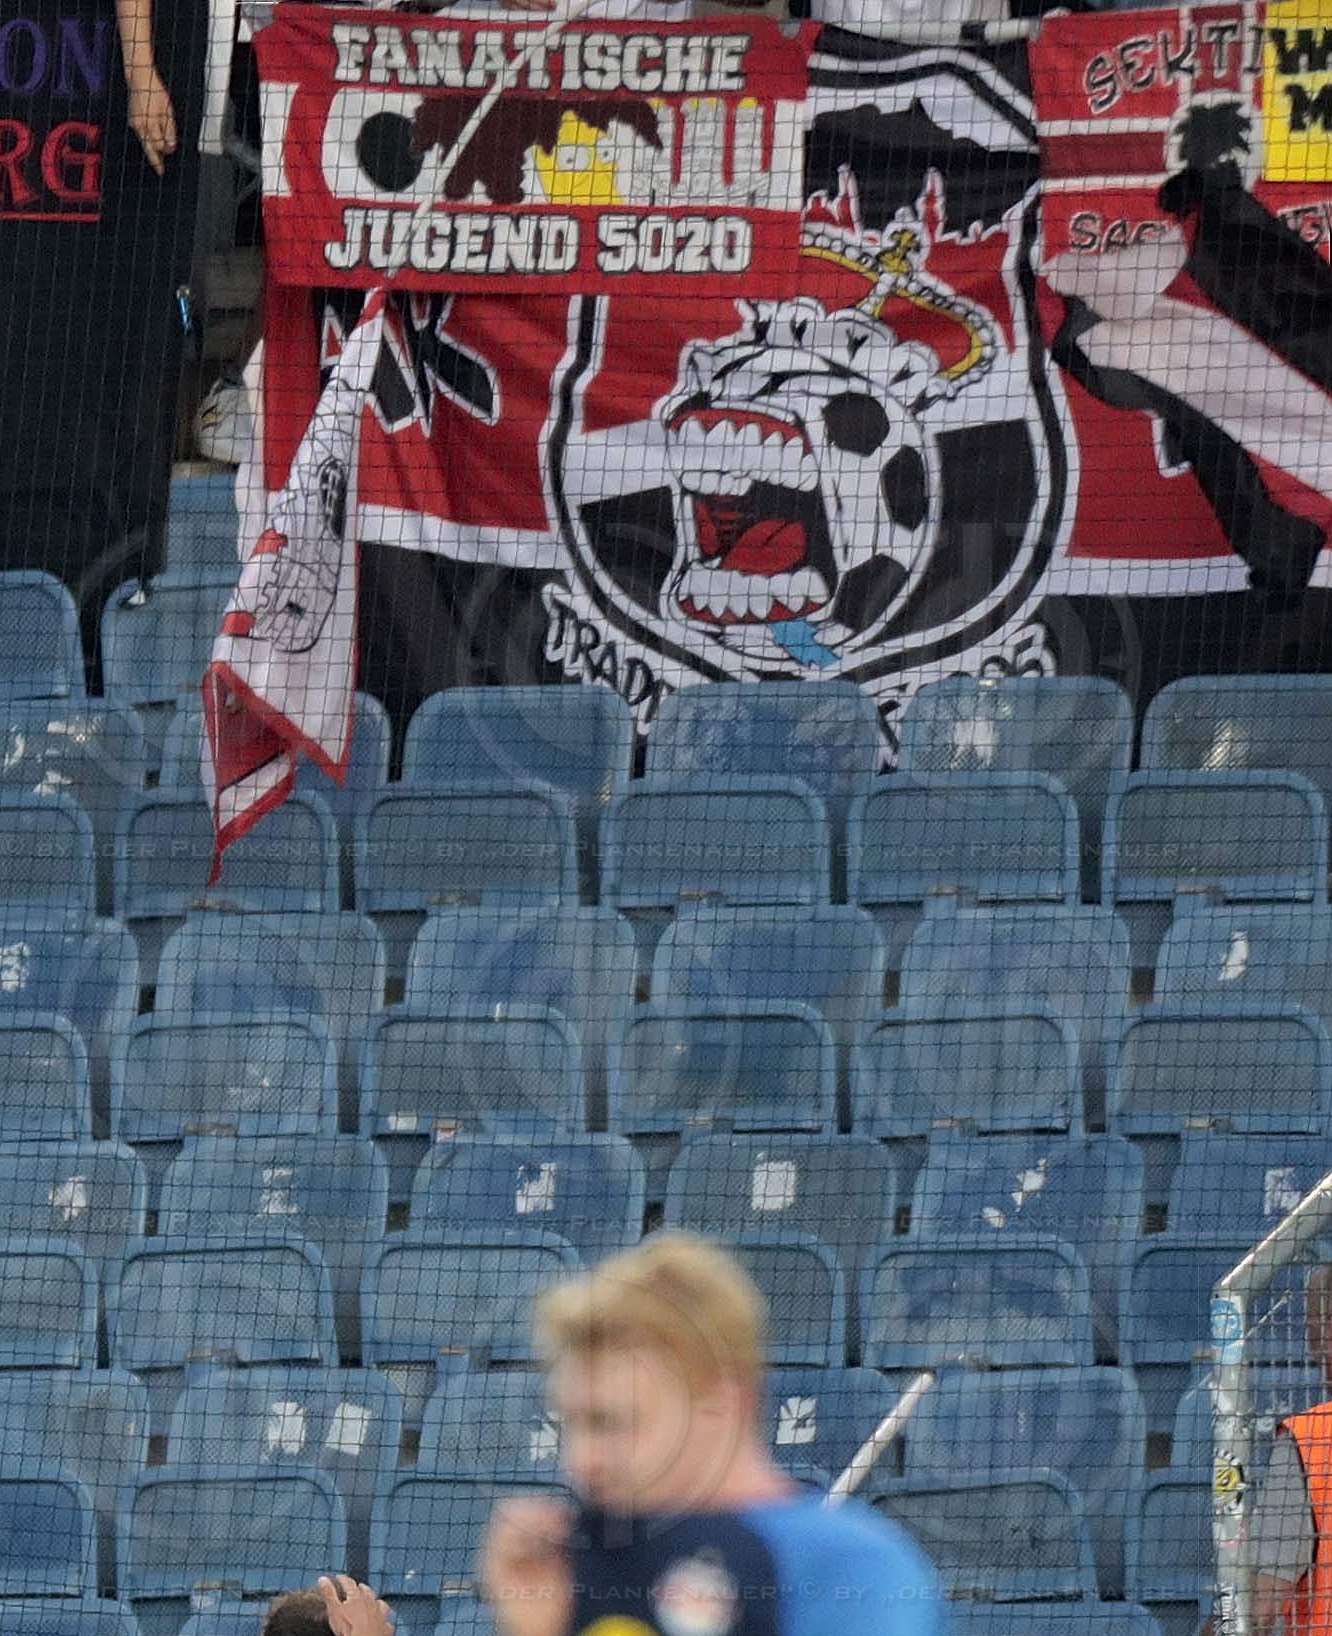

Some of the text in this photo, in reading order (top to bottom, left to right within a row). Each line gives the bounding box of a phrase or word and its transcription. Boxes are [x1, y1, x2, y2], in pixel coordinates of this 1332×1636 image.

[331, 24, 751, 92] FANATISCHE
[324, 208, 754, 275] JUGEND 5020
